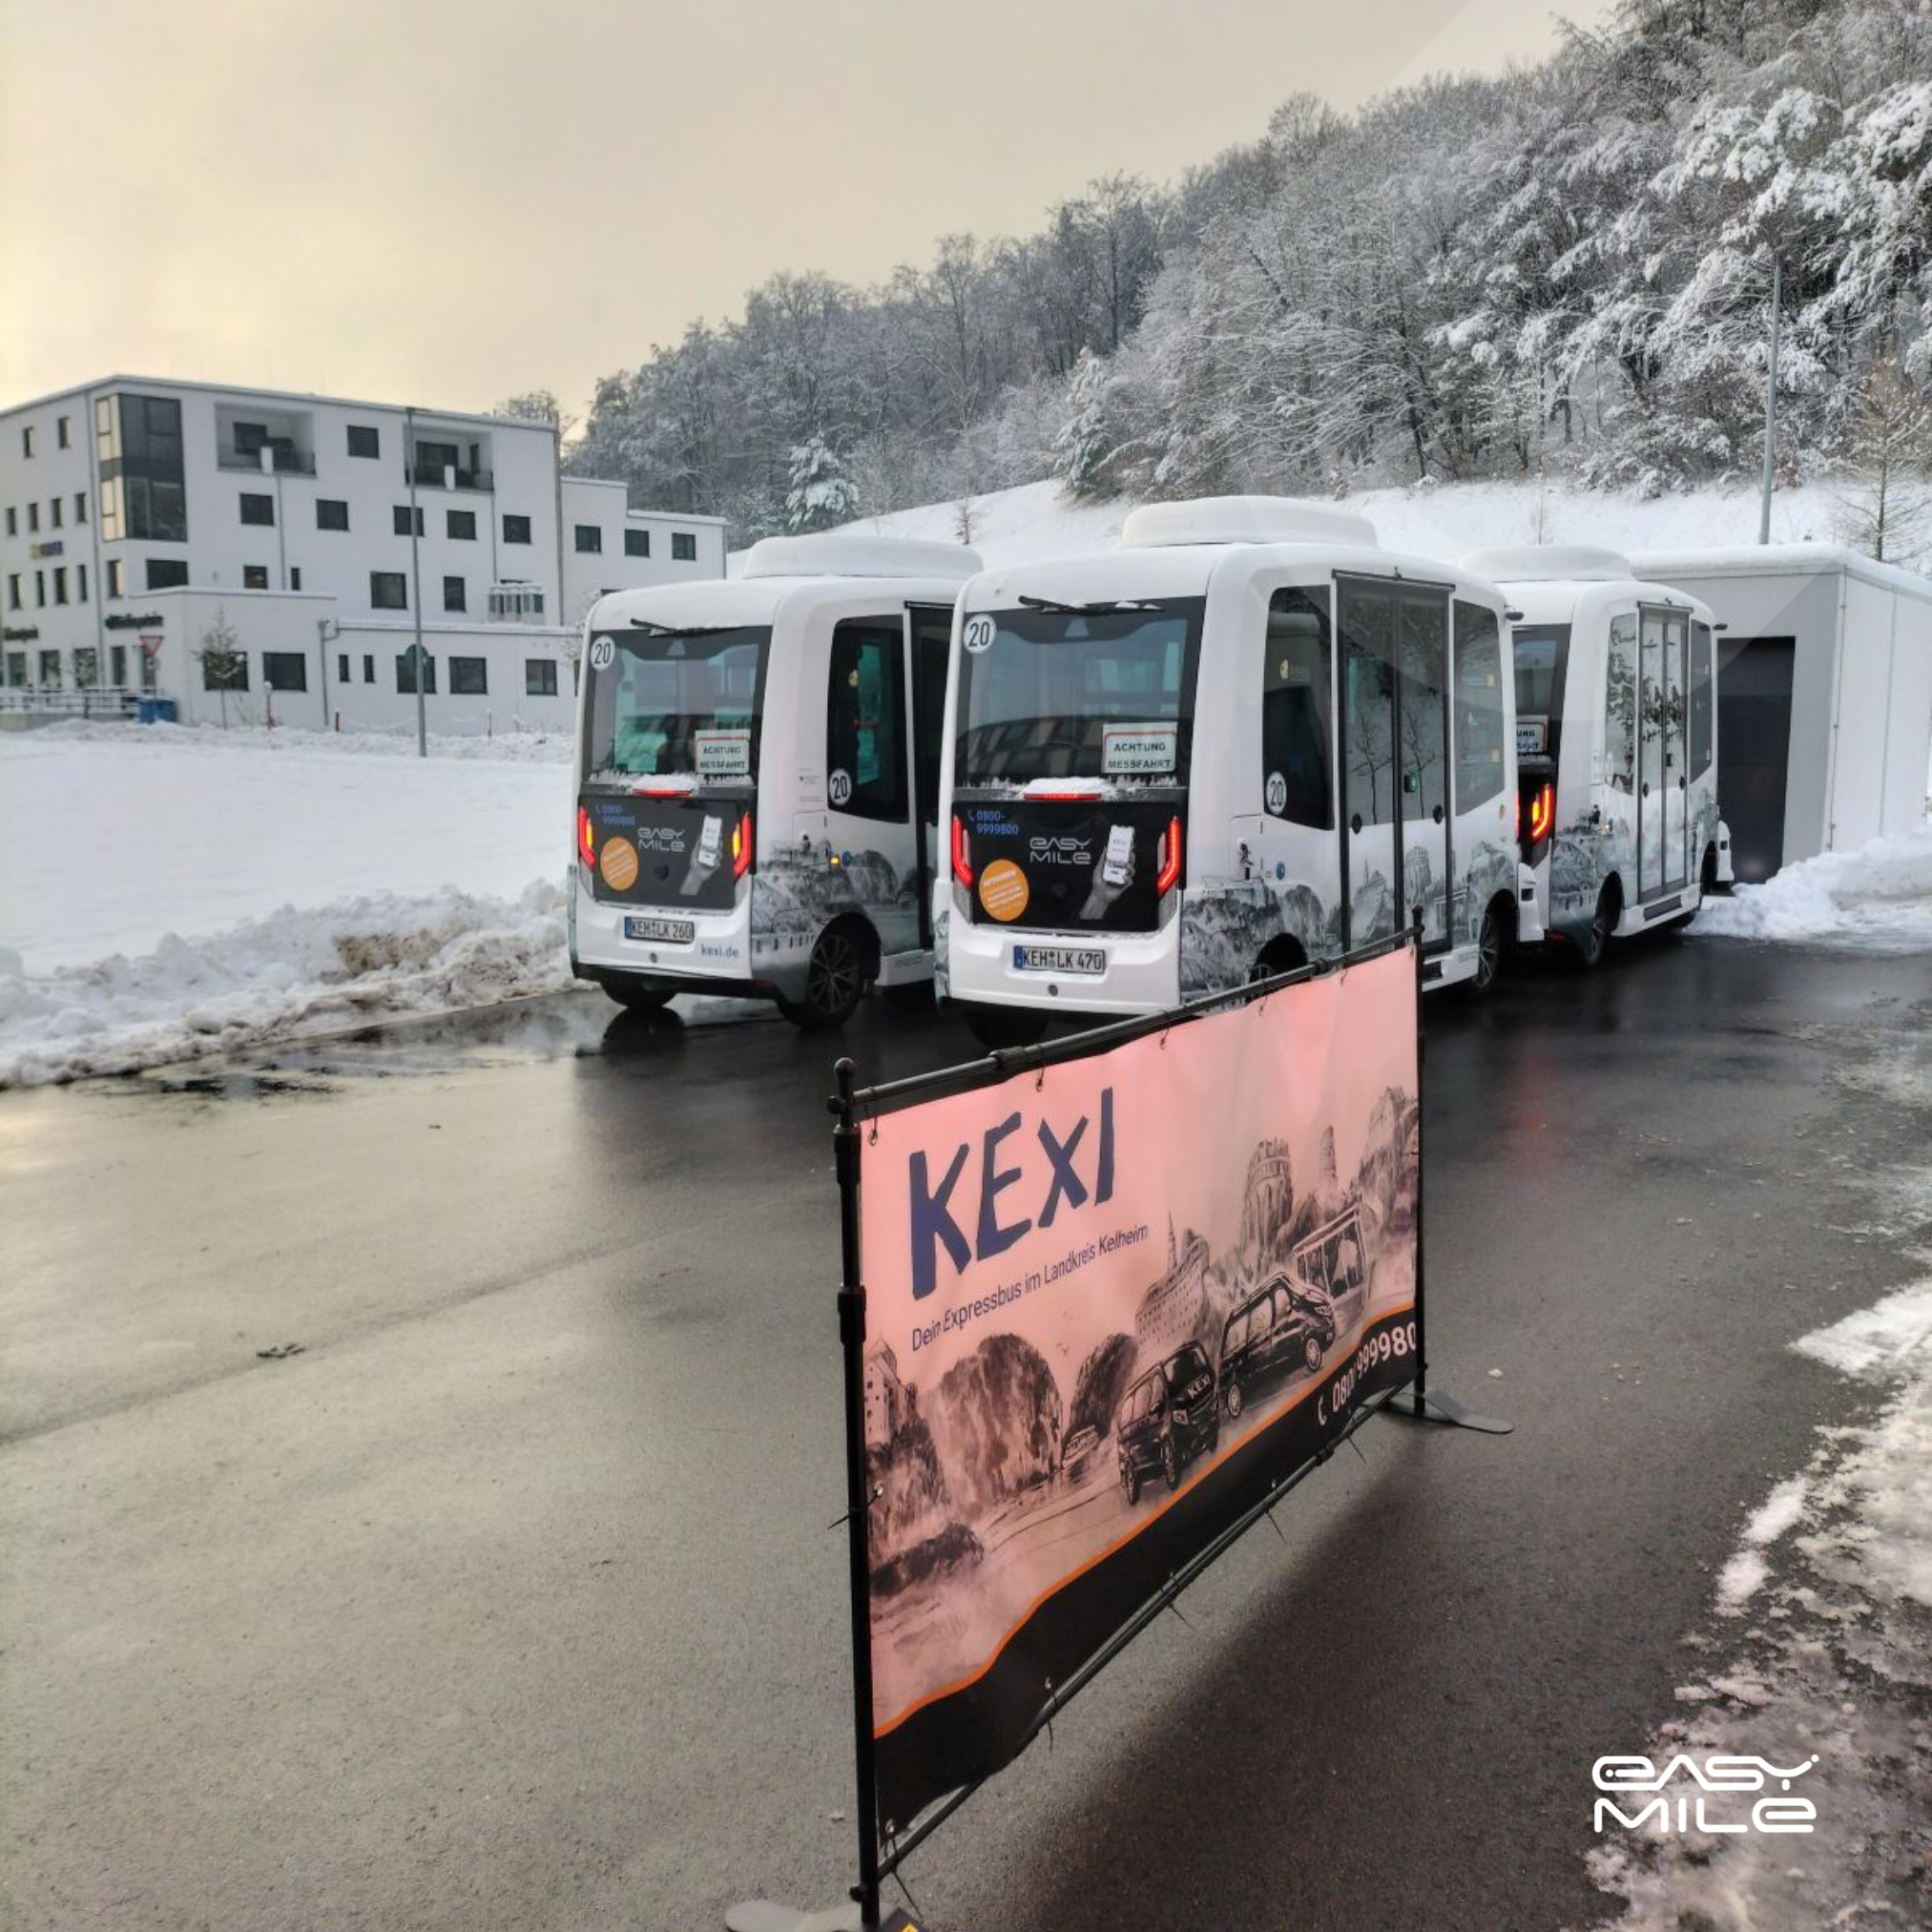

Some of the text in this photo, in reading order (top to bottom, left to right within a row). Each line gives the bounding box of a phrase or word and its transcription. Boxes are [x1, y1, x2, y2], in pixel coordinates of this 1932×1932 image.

[968, 621, 990, 648] 20
[593, 643, 611, 664] 20
[1113, 741, 1166, 753] ACHTUNG
[1108, 758, 1172, 770] MESSFAHRT
[832, 776, 848, 800] 20
[1270, 779, 1284, 805] 20
[1023, 949, 1102, 970] KEH LK 470
[909, 1086, 1115, 1301] KEXI
[912, 1224, 1149, 1352] Dein Expressbus im Landkreis Kelheim
